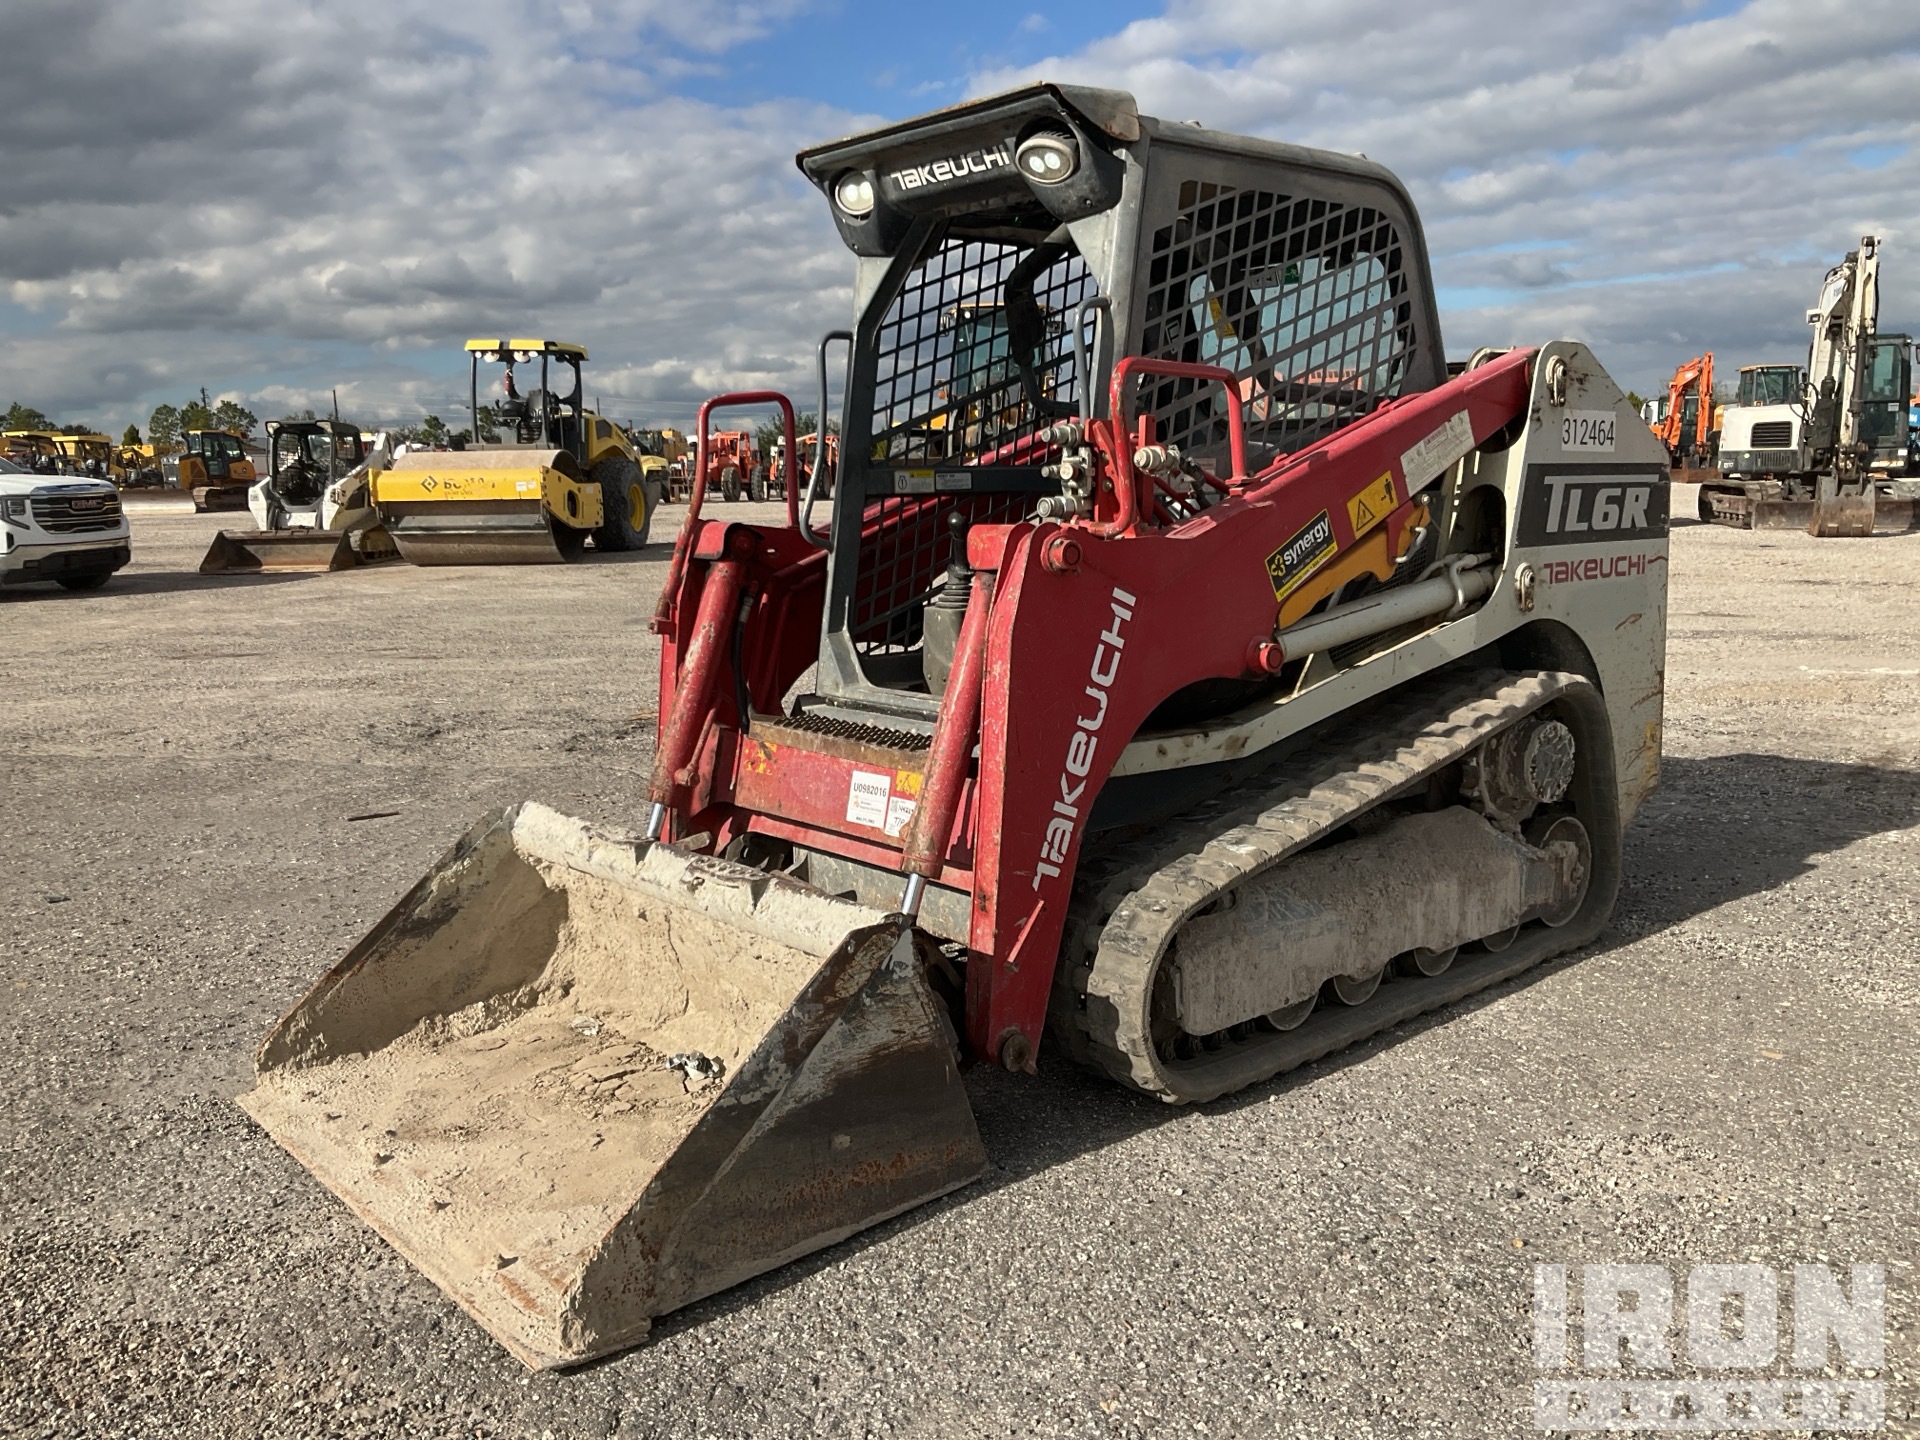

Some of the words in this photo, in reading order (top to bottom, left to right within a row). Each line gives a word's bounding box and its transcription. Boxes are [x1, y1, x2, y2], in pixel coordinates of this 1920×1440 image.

[1562, 417, 1615, 446] 312464
[1544, 473, 1660, 533] TL6R
[1283, 517, 1330, 566] synergy
[853, 782, 887, 798] U0982016
